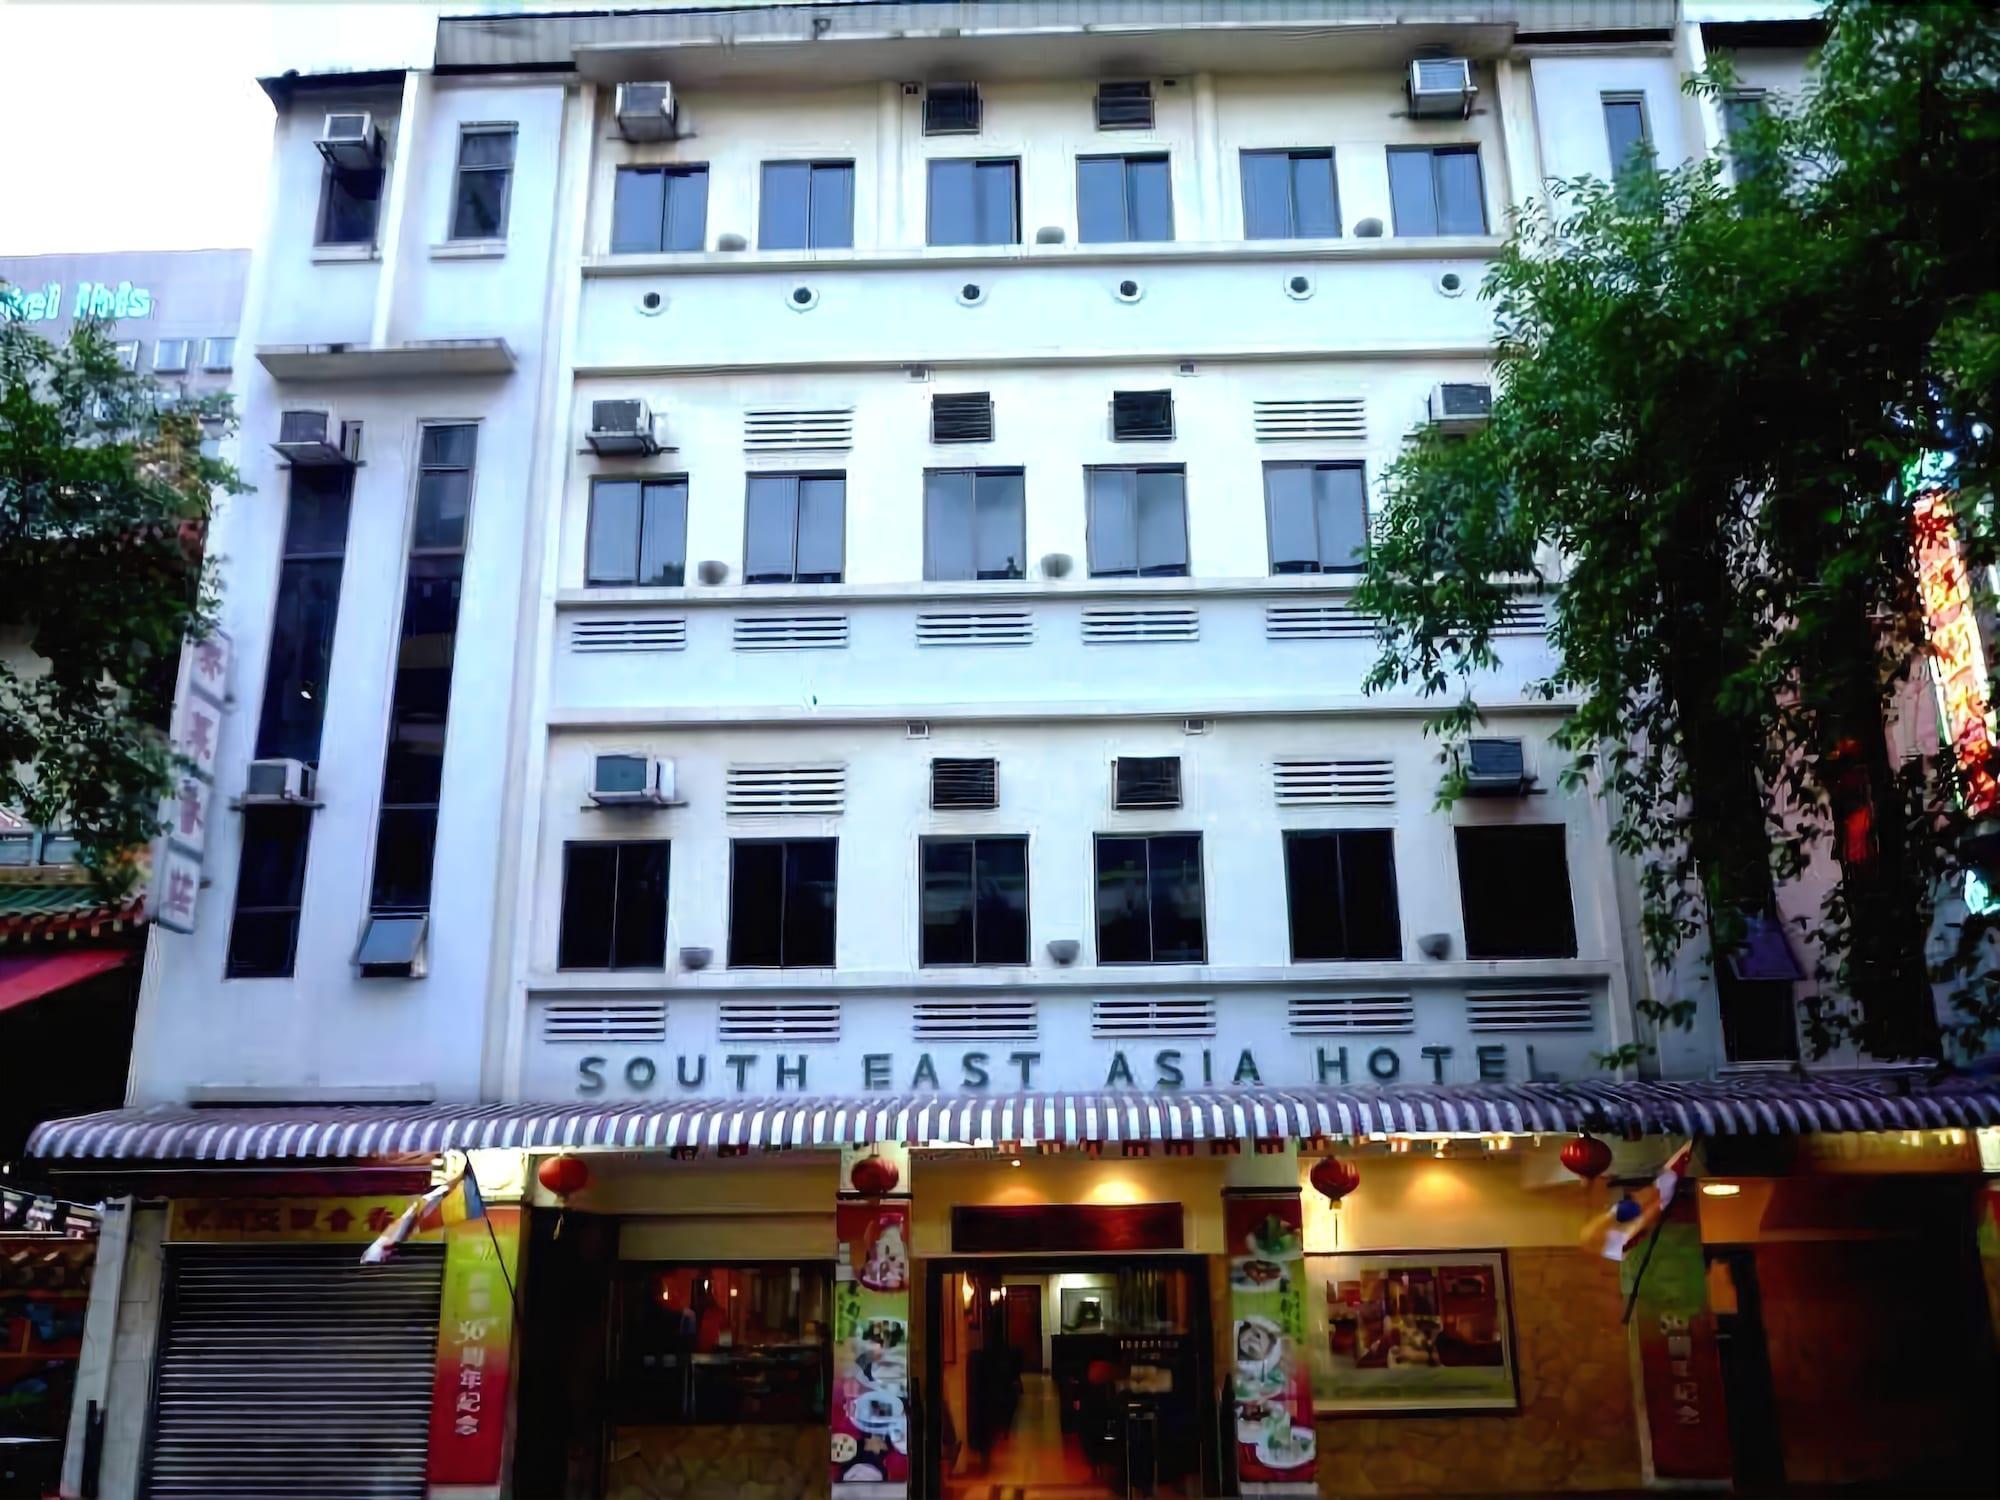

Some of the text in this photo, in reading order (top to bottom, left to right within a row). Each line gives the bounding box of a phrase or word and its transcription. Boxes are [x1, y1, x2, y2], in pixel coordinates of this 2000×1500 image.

[577, 1044, 1560, 1096] SOUTH EAST ASIA HOTEL
